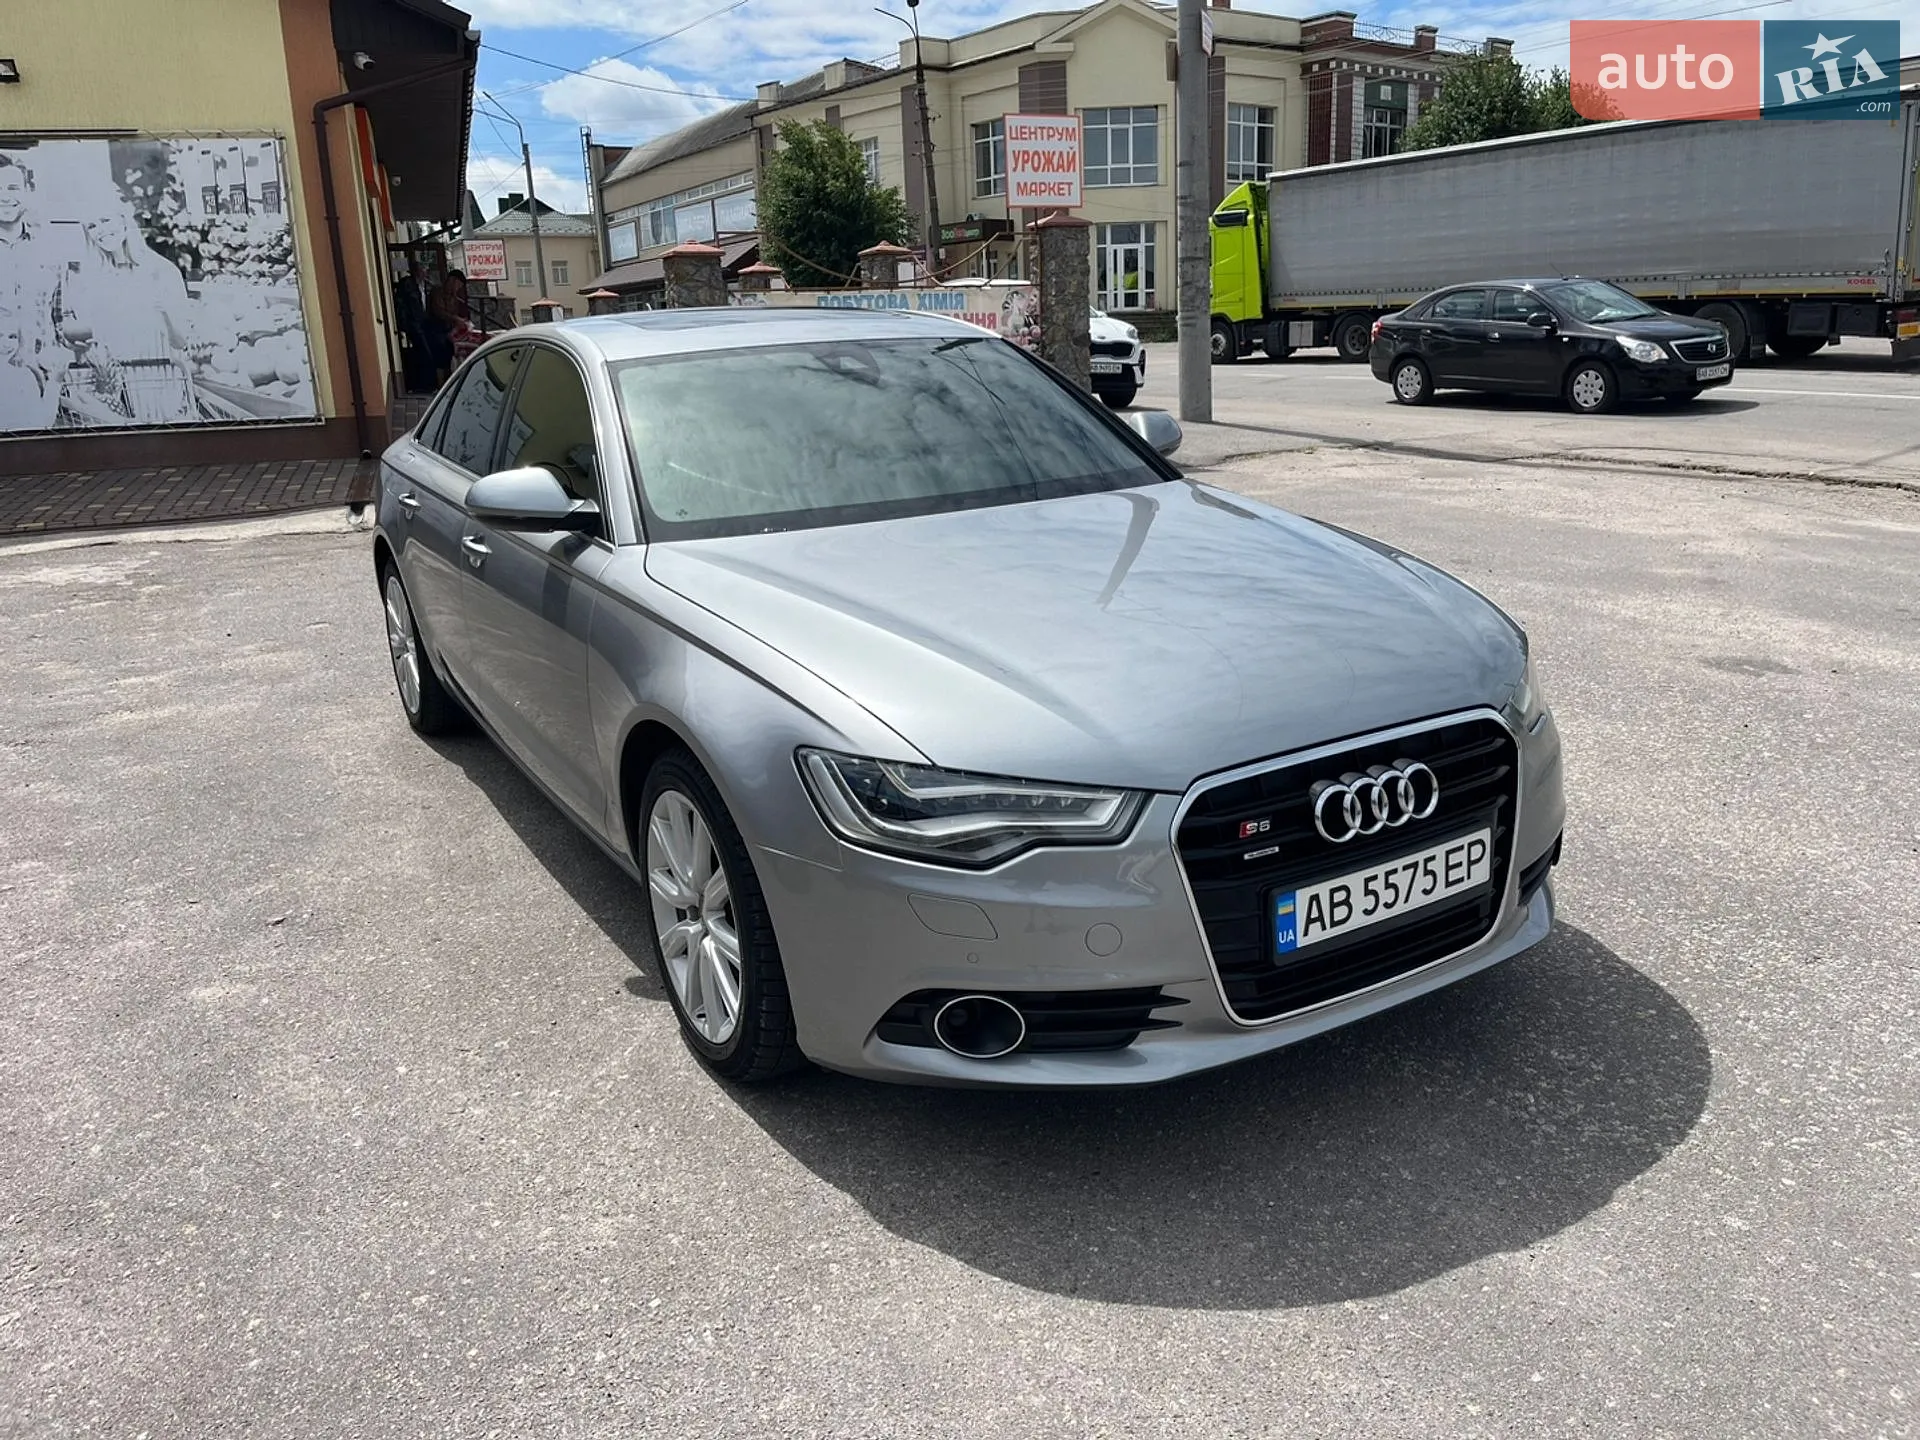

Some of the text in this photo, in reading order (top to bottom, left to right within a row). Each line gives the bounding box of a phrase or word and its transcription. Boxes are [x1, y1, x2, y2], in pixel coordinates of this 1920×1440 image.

[1009, 125, 1077, 141] ЦЕНТРУМ
[1011, 146, 1077, 173] УРОЖАЙ
[1016, 181, 1074, 197] МАРКЕТ
[467, 252, 504, 265] УРОЖАЙ
[817, 292, 966, 310] ПОБУТОВА ХІМІЯ
[1302, 838, 1487, 937] AB 5575 EP
[1278, 930, 1296, 944] UA
